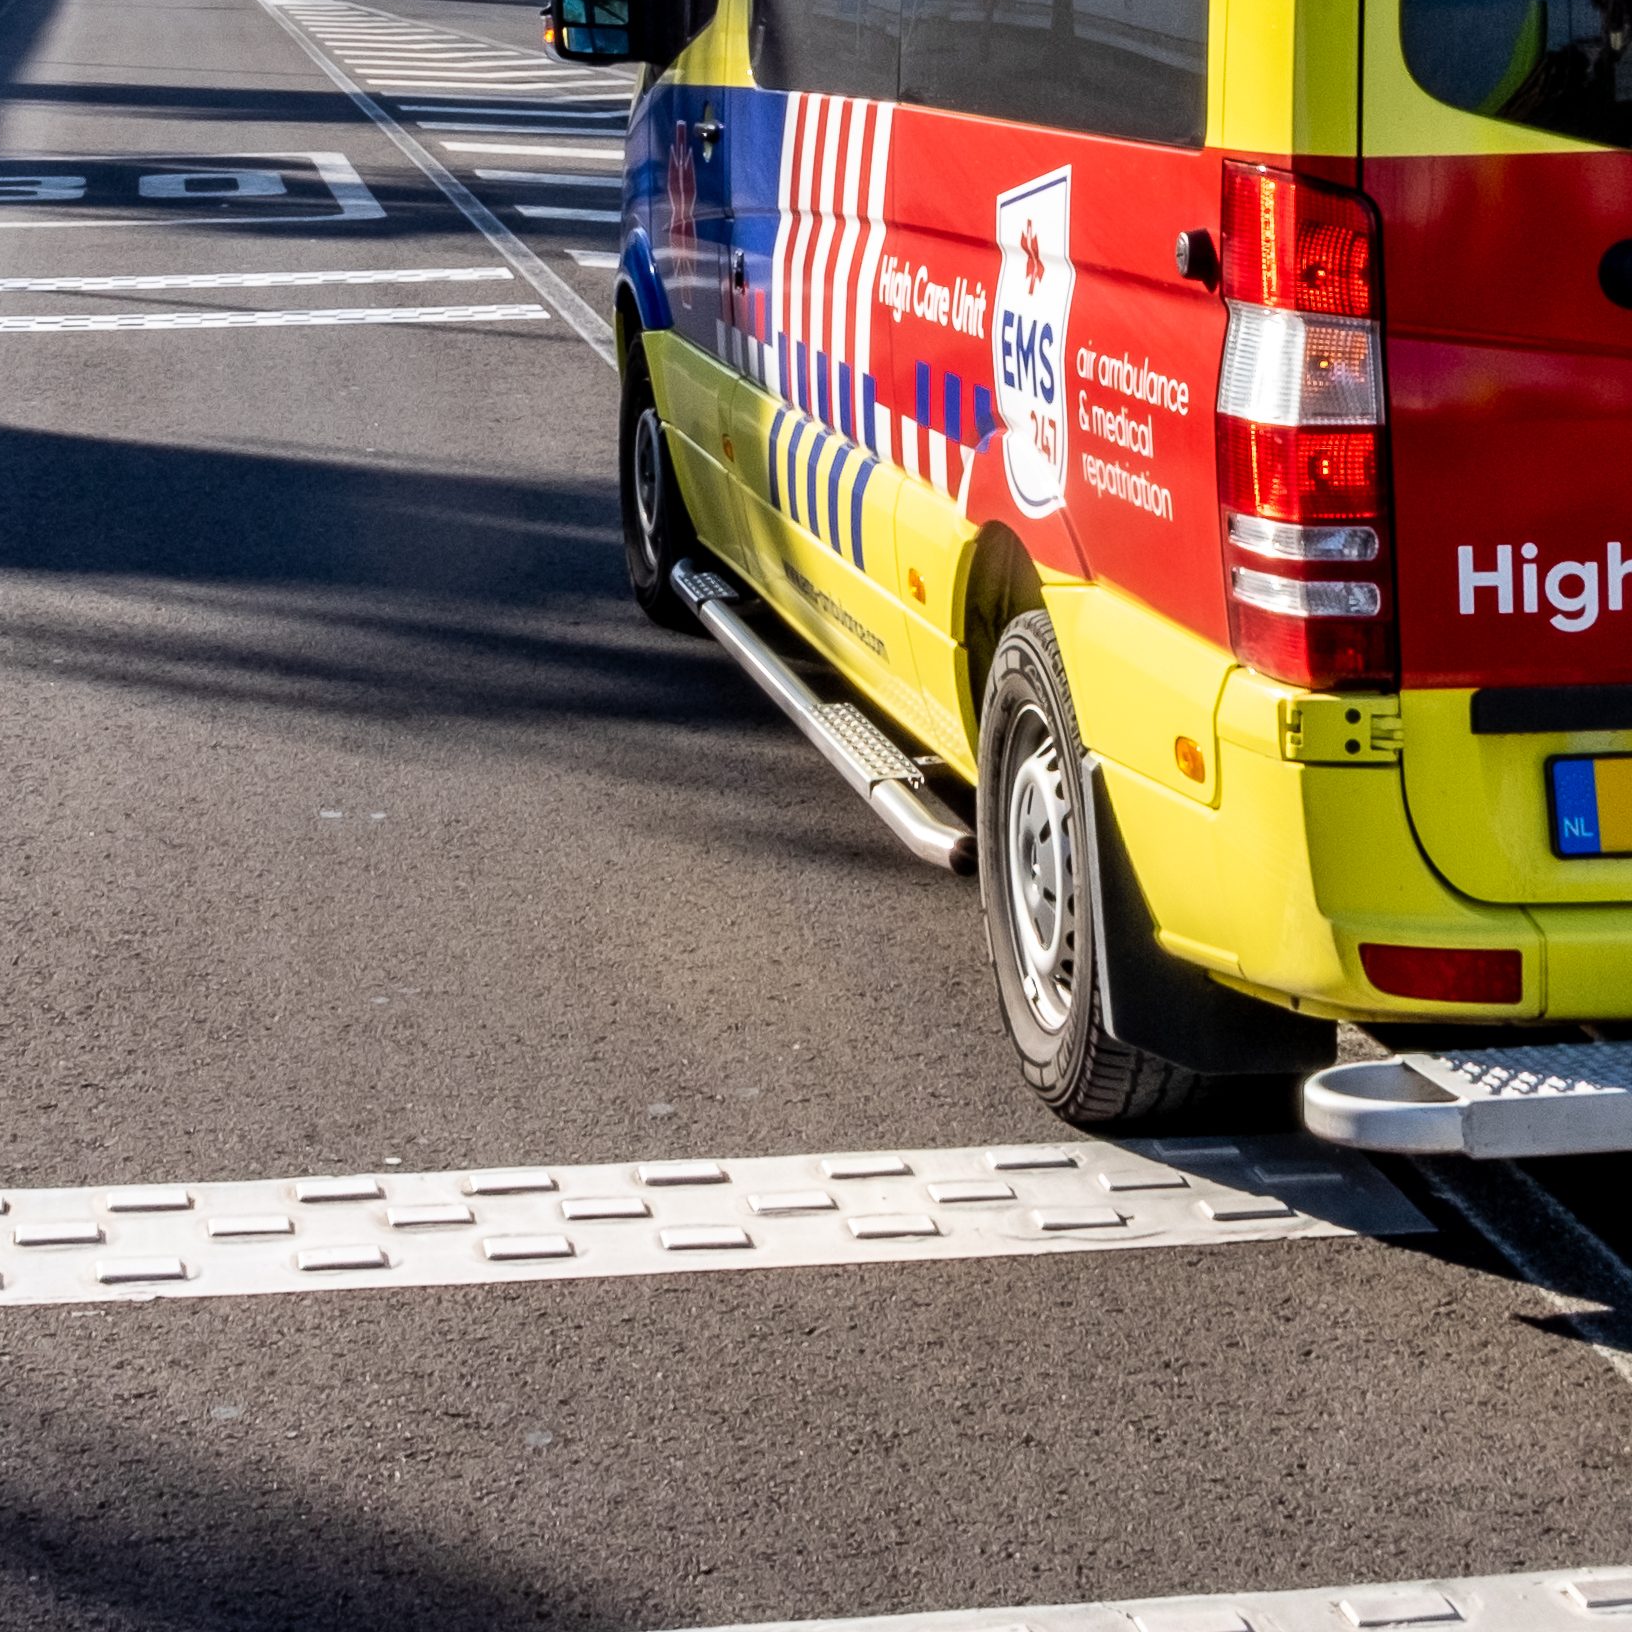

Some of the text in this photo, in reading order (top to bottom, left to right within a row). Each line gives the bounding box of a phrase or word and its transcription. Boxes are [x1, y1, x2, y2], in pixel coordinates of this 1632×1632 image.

[879, 255, 987, 339] High Care Unit
[1003, 310, 1055, 405] EMS
[1076, 340, 1189, 416] air ambulance
[1078, 390, 1153, 459] & medical
[1081, 451, 1174, 522] repatriation
[1563, 817, 1593, 838] NL
